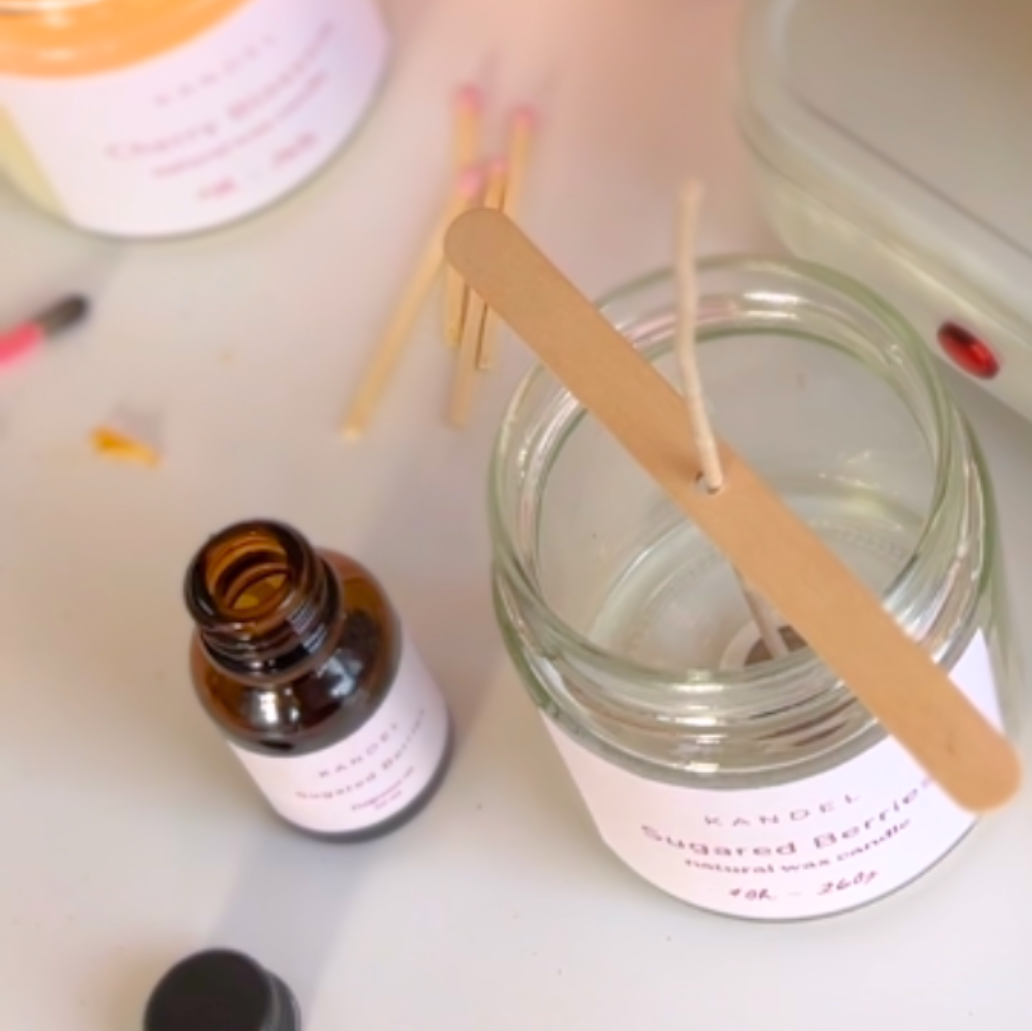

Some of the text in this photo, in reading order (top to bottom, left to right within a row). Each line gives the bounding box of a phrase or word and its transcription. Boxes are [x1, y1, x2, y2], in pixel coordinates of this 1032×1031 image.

[704, 794, 861, 826] KANDEL
[641, 825, 797, 856] Sugared
[685, 818, 910, 874] natural wax candle
